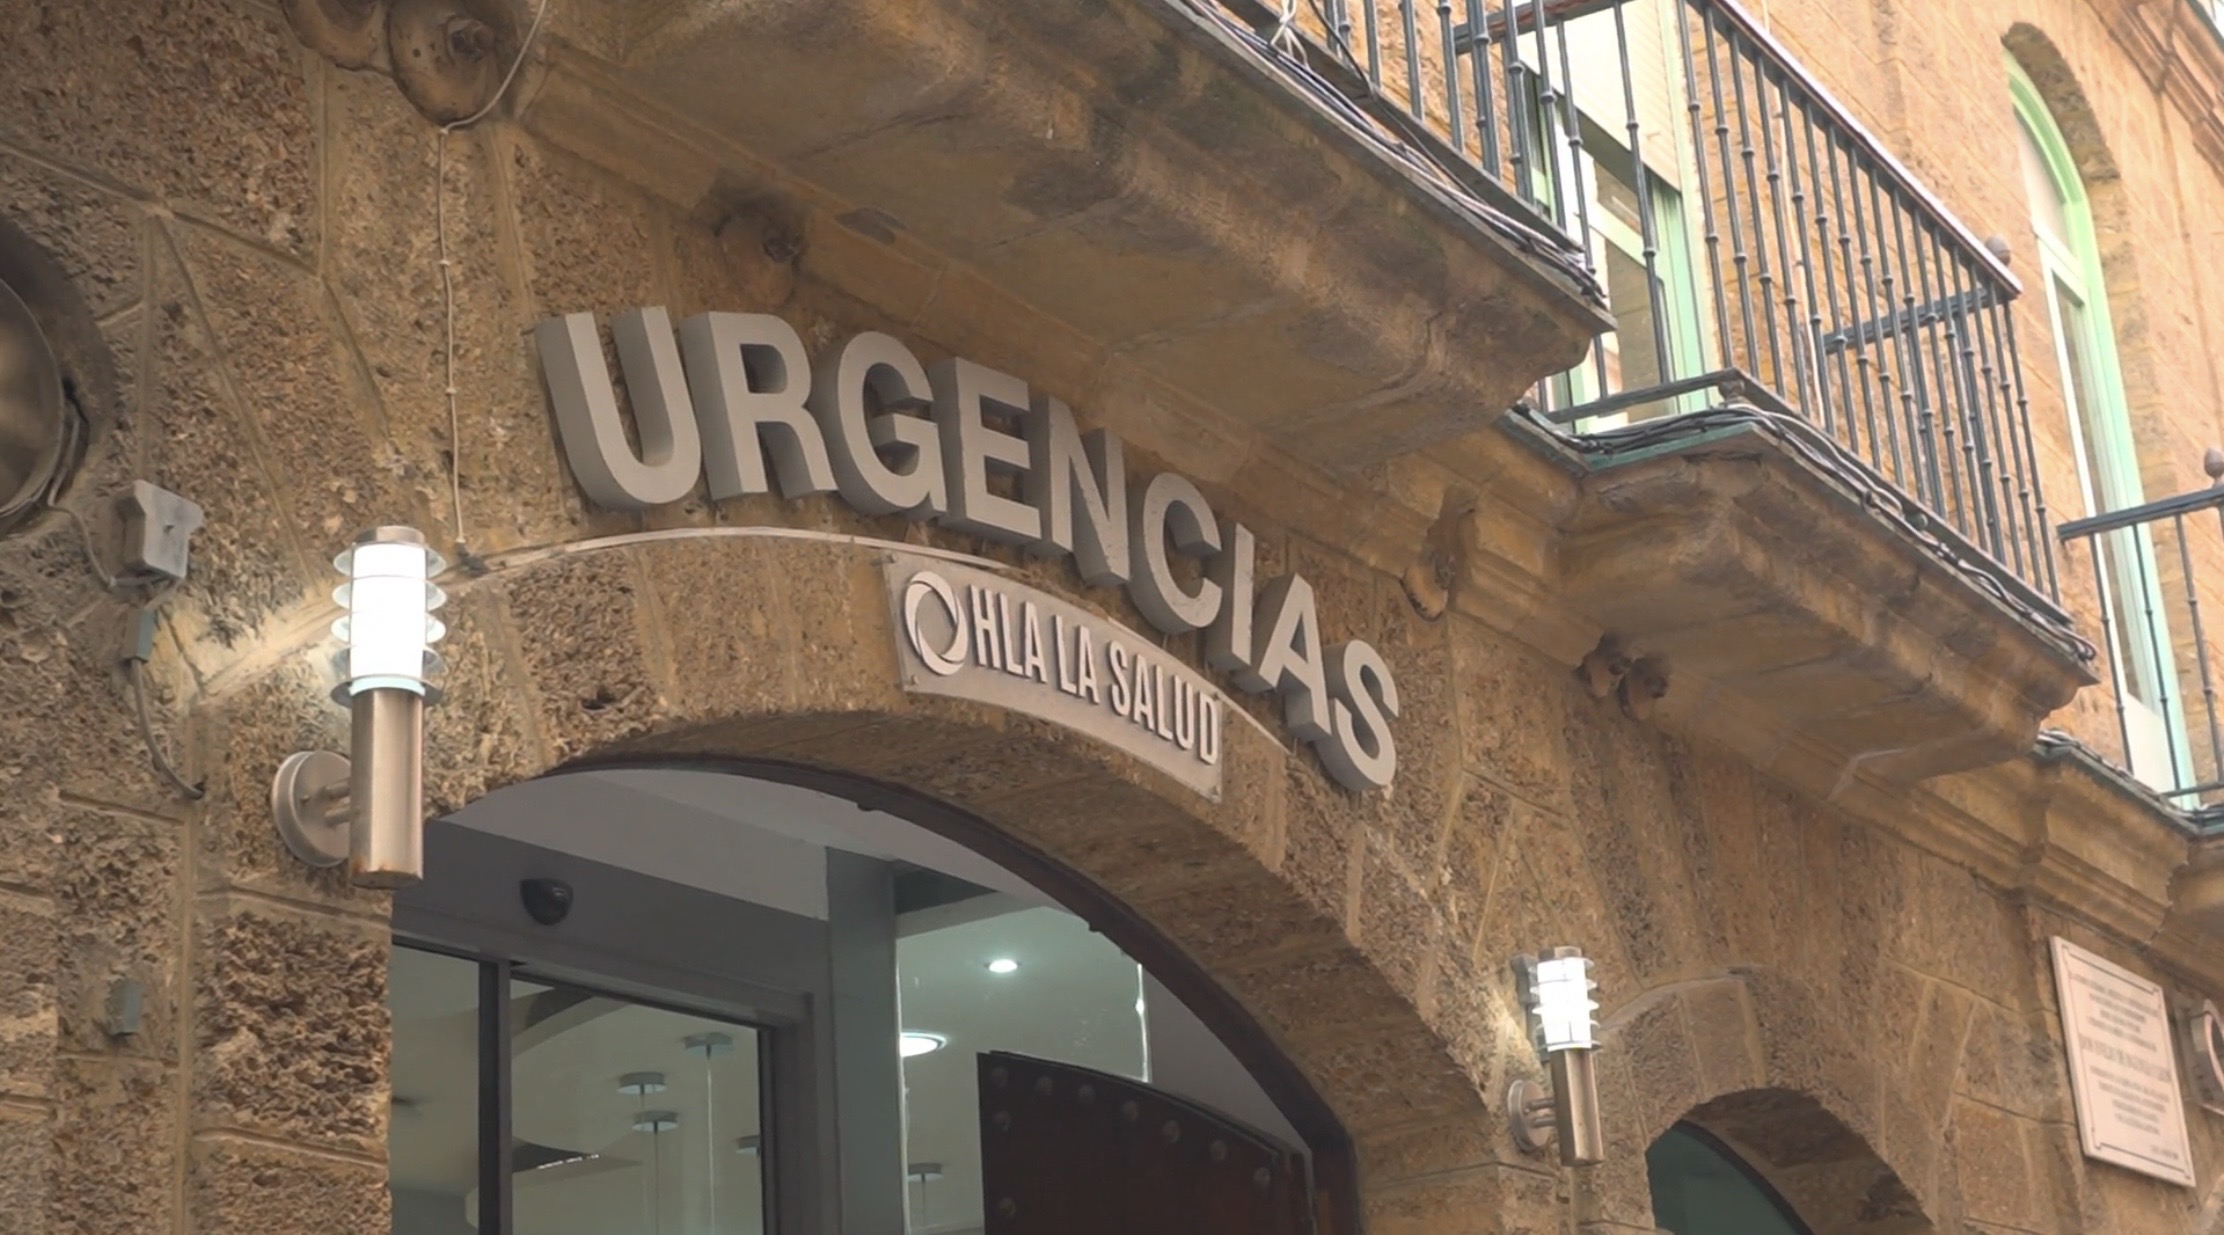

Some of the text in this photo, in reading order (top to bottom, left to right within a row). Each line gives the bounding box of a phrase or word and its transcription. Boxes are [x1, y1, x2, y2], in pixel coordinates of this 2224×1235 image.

[535, 305, 1399, 791] URGENCIAS
[1052, 614, 1100, 705] LA
[1107, 639, 1219, 766] SALUD
